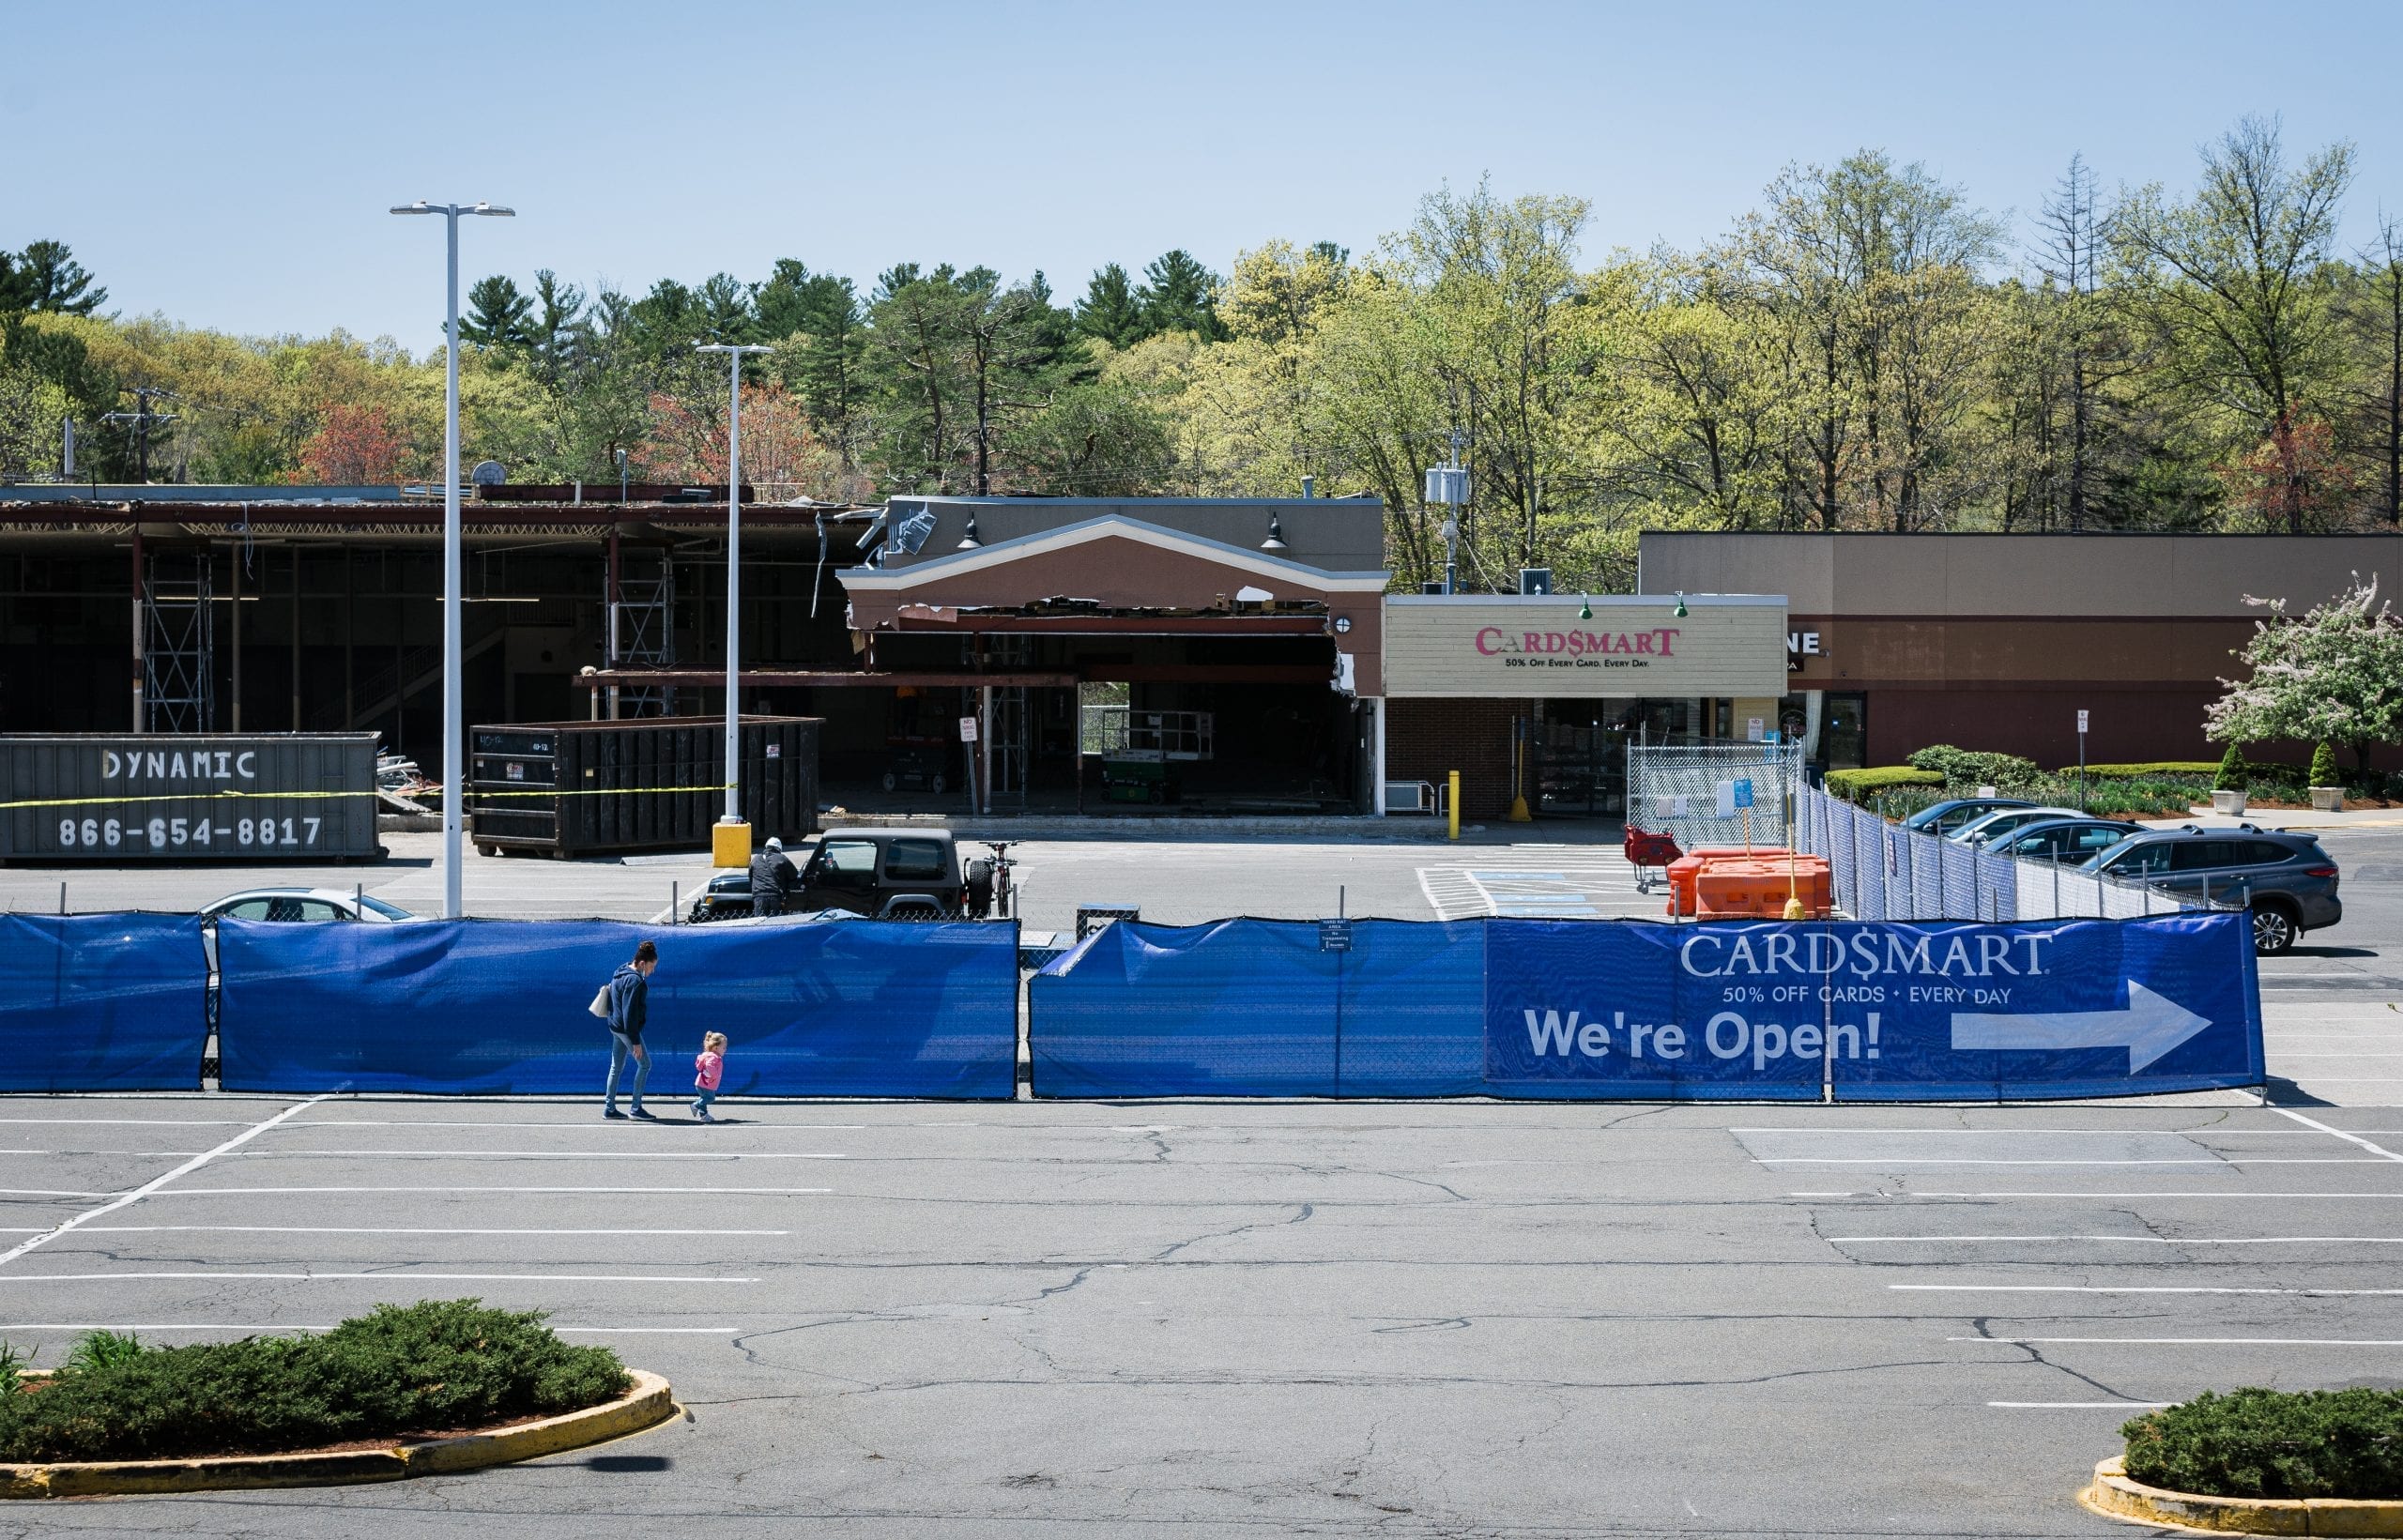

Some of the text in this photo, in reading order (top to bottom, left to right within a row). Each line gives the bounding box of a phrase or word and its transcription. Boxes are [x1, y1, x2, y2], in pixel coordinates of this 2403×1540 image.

[1506, 659, 1525, 667] 50%
[103, 751, 255, 779] DYNAMIC
[59, 817, 321, 847] 866-654-8817
[1722, 986, 2012, 1004] 50% OFF CARDS EVERY DAY
[1524, 1010, 1880, 1071] We're Open!
